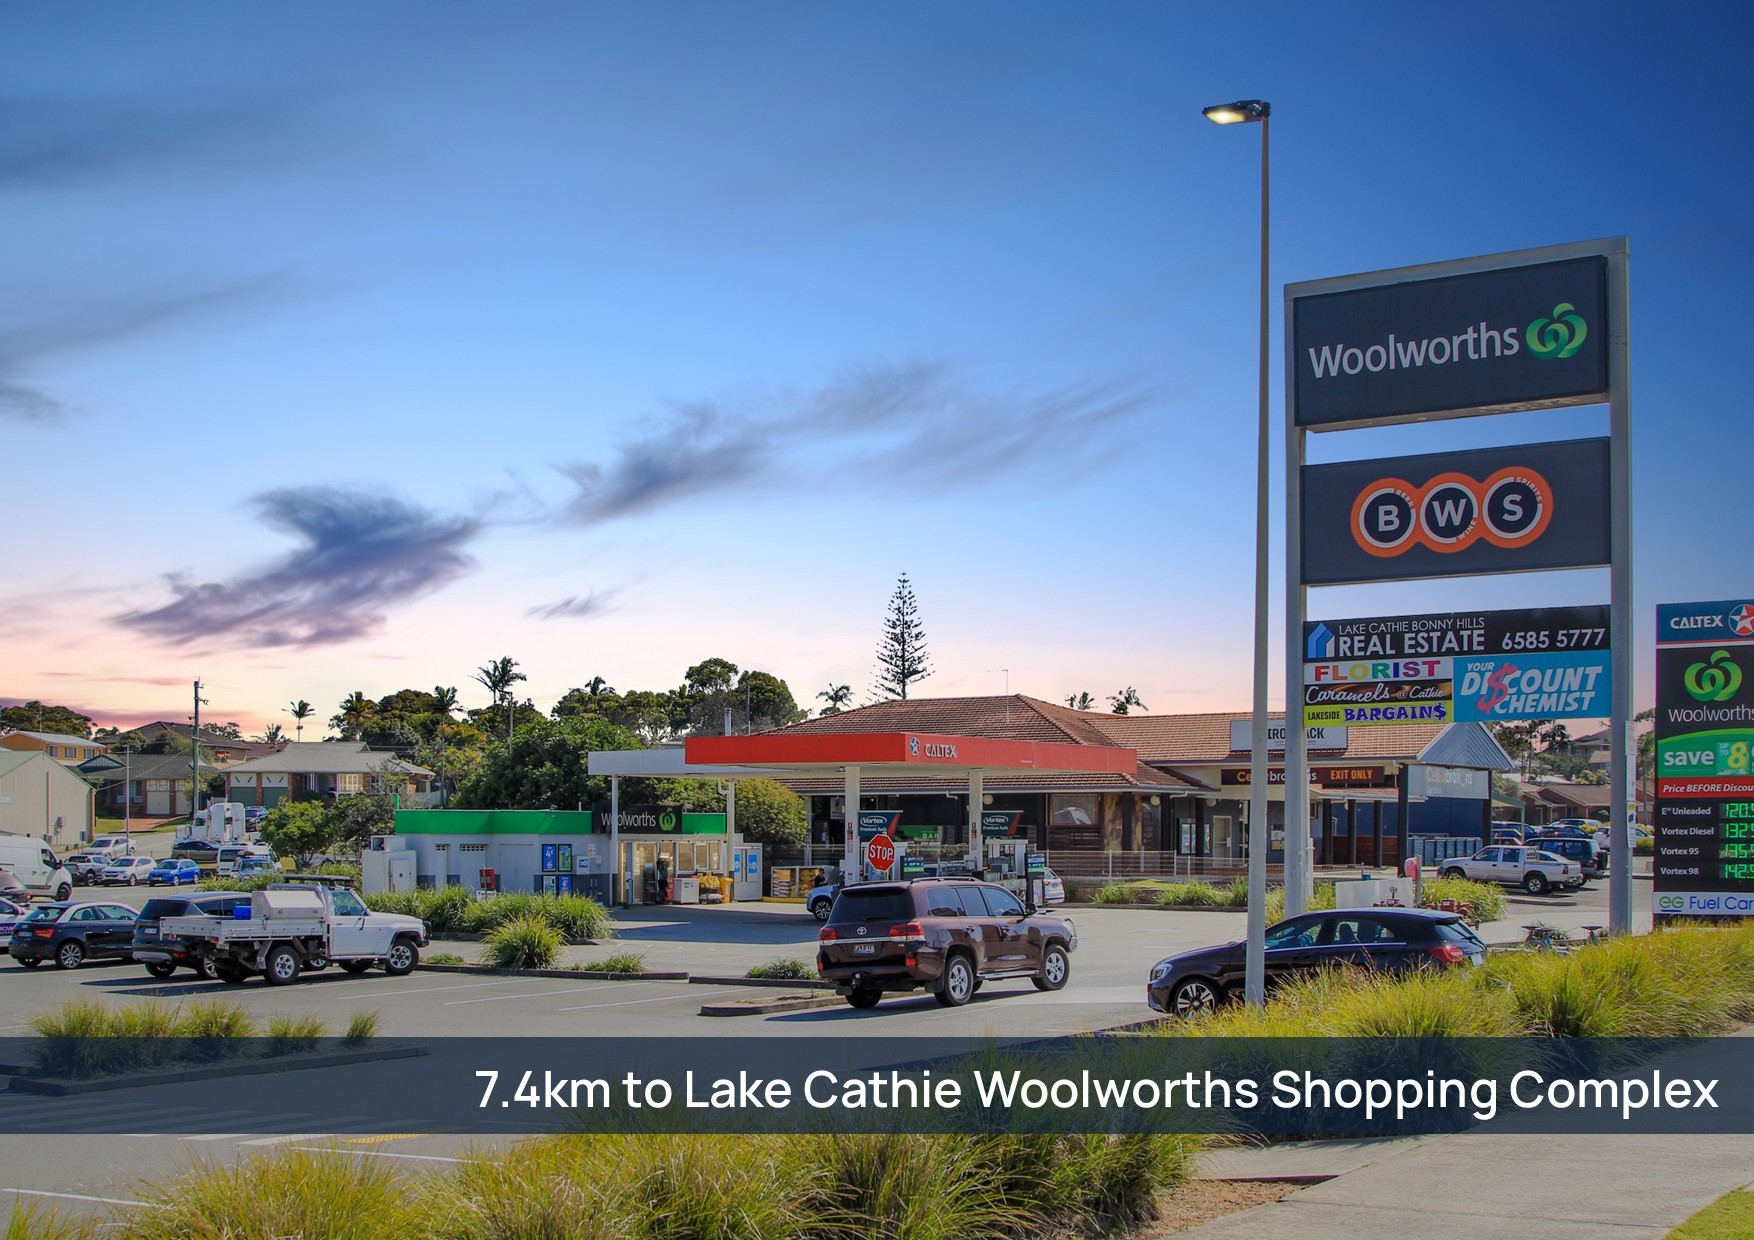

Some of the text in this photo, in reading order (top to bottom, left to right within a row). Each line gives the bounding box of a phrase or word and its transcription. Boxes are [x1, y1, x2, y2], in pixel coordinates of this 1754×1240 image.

[1308, 322, 1520, 378] Woolworths
[1395, 488, 1414, 508] BEER
[1516, 476, 1543, 504] SPIRITS
[1457, 519, 1477, 540] WINE
[1339, 617, 1485, 635] LAKE CATHIE BONNY HILLS
[1670, 615, 1724, 629] CALTEX
[1339, 630, 1485, 657] REAL ESTATE
[1501, 628, 1606, 651] 6585 5777
[1314, 660, 1441, 682] FLORIST
[1467, 662, 1495, 672] YOUR
[1305, 683, 1390, 704] Caramels
[1409, 685, 1445, 699] Cathie
[1494, 691, 1596, 714] CHEMIST
[1307, 711, 1340, 721] LAKESIDE
[925, 743, 957, 758] CALTEX
[1664, 750, 1715, 766] save
[1727, 742, 1747, 768] 8
[1330, 769, 1349, 780] EXIT
[1351, 768, 1373, 780] ONLY
[1663, 783, 1754, 793] Price BEFORE Discou
[601, 811, 657, 827] Wolworths
[1672, 807, 1711, 815] Unleaded
[1661, 827, 1688, 835] Vortex
[1689, 827, 1715, 835] Diesel
[869, 844, 894, 861] STOP
[1660, 847, 1688, 855] Vortex
[1688, 847, 1699, 855] 95
[1660, 867, 1688, 875] Vortex
[1688, 867, 1699, 875] 98
[1689, 896, 1720, 910] Fuel
[1724, 896, 1754, 910] Car
